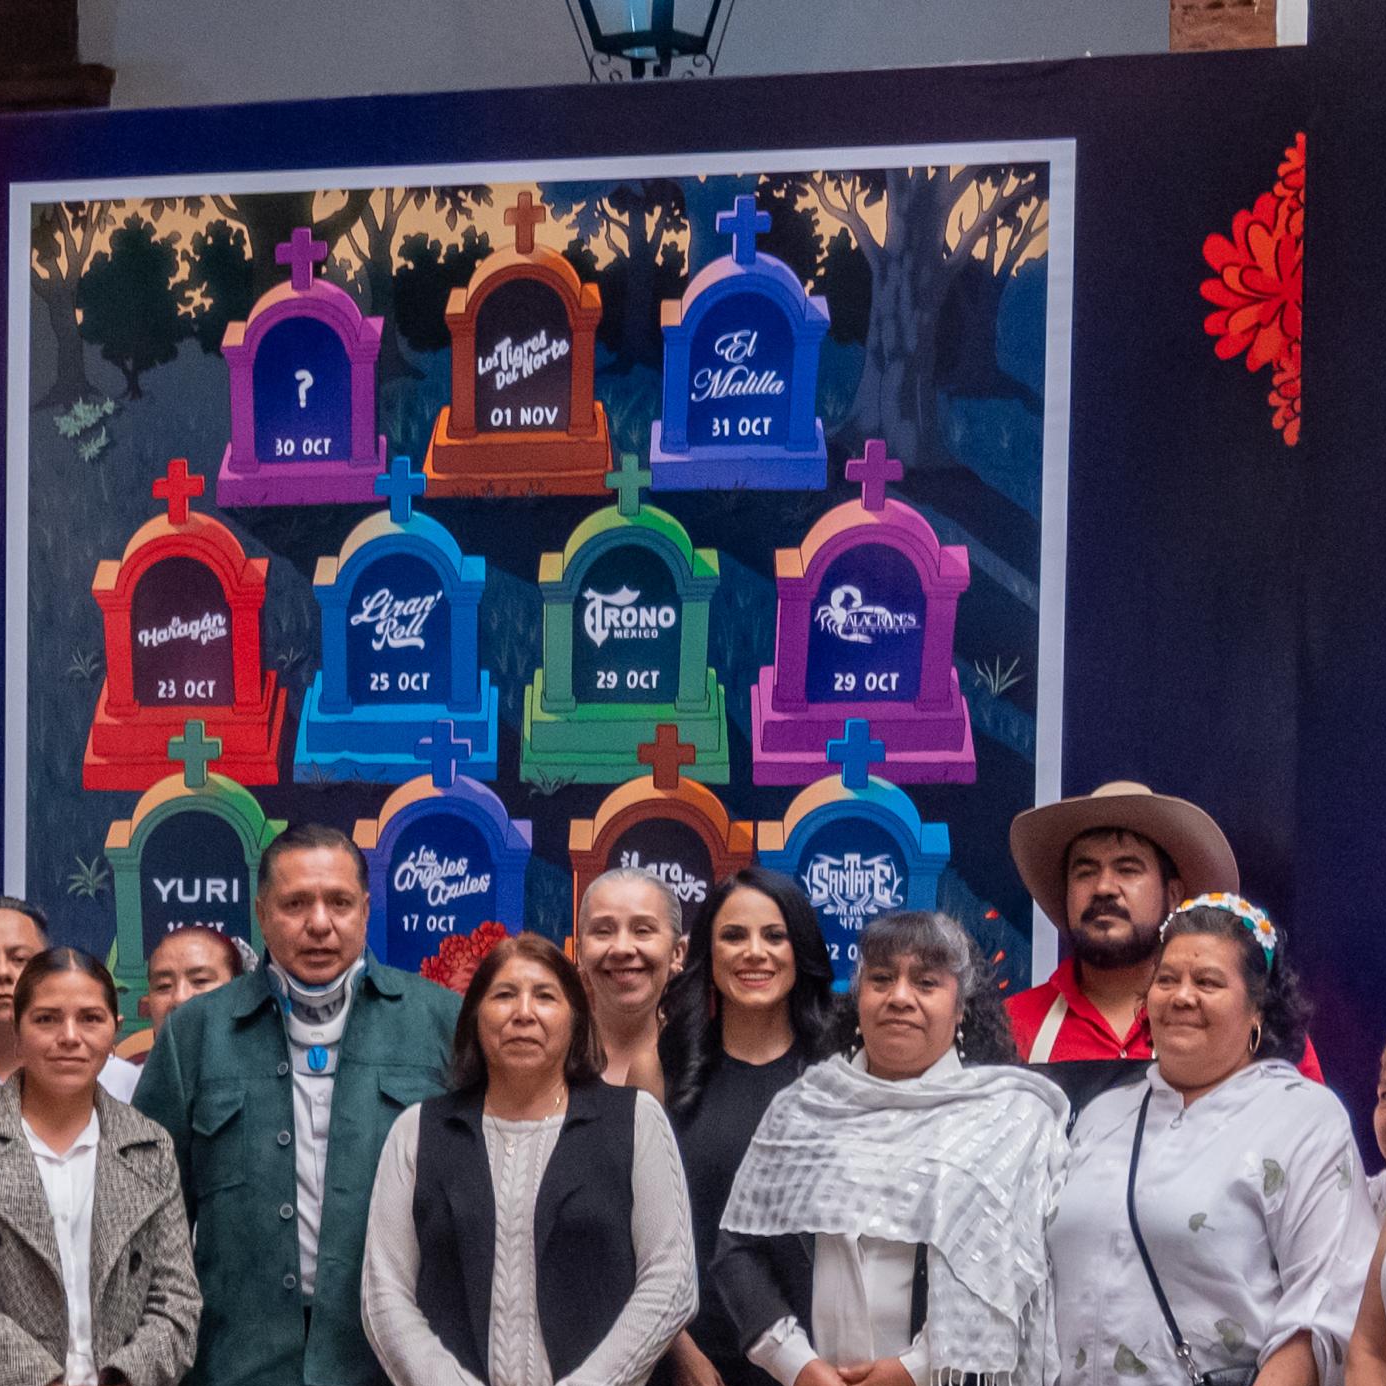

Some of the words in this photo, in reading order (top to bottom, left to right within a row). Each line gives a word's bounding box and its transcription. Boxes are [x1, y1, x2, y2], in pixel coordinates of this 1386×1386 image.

[478, 351, 499, 376] Los
[495, 329, 548, 371] Tigres
[714, 329, 758, 364] El
[495, 364, 519, 390] Del
[522, 339, 570, 378] Norte
[294, 368, 314, 408] ?
[691, 364, 786, 402] Malilla
[490, 407, 512, 426] 01
[520, 406, 559, 426] NOV
[712, 417, 730, 437] 31
[738, 416, 772, 436] OCT
[275, 438, 295, 456] 30
[302, 438, 332, 455] OCT
[582, 584, 676, 649] TRONO
[372, 612, 425, 651] Roll
[157, 679, 176, 699] 23
[184, 680, 216, 698] OCT
[370, 672, 390, 691] 25
[398, 672, 430, 691] OCT
[596, 670, 618, 689] 29
[626, 670, 660, 689] OCT
[834, 672, 856, 691] 29
[864, 672, 900, 691] OCT
[153, 878, 239, 903] YURI
[402, 914, 419, 932] 17
[426, 915, 456, 932] OCT
[826, 944, 840, 961] 2
